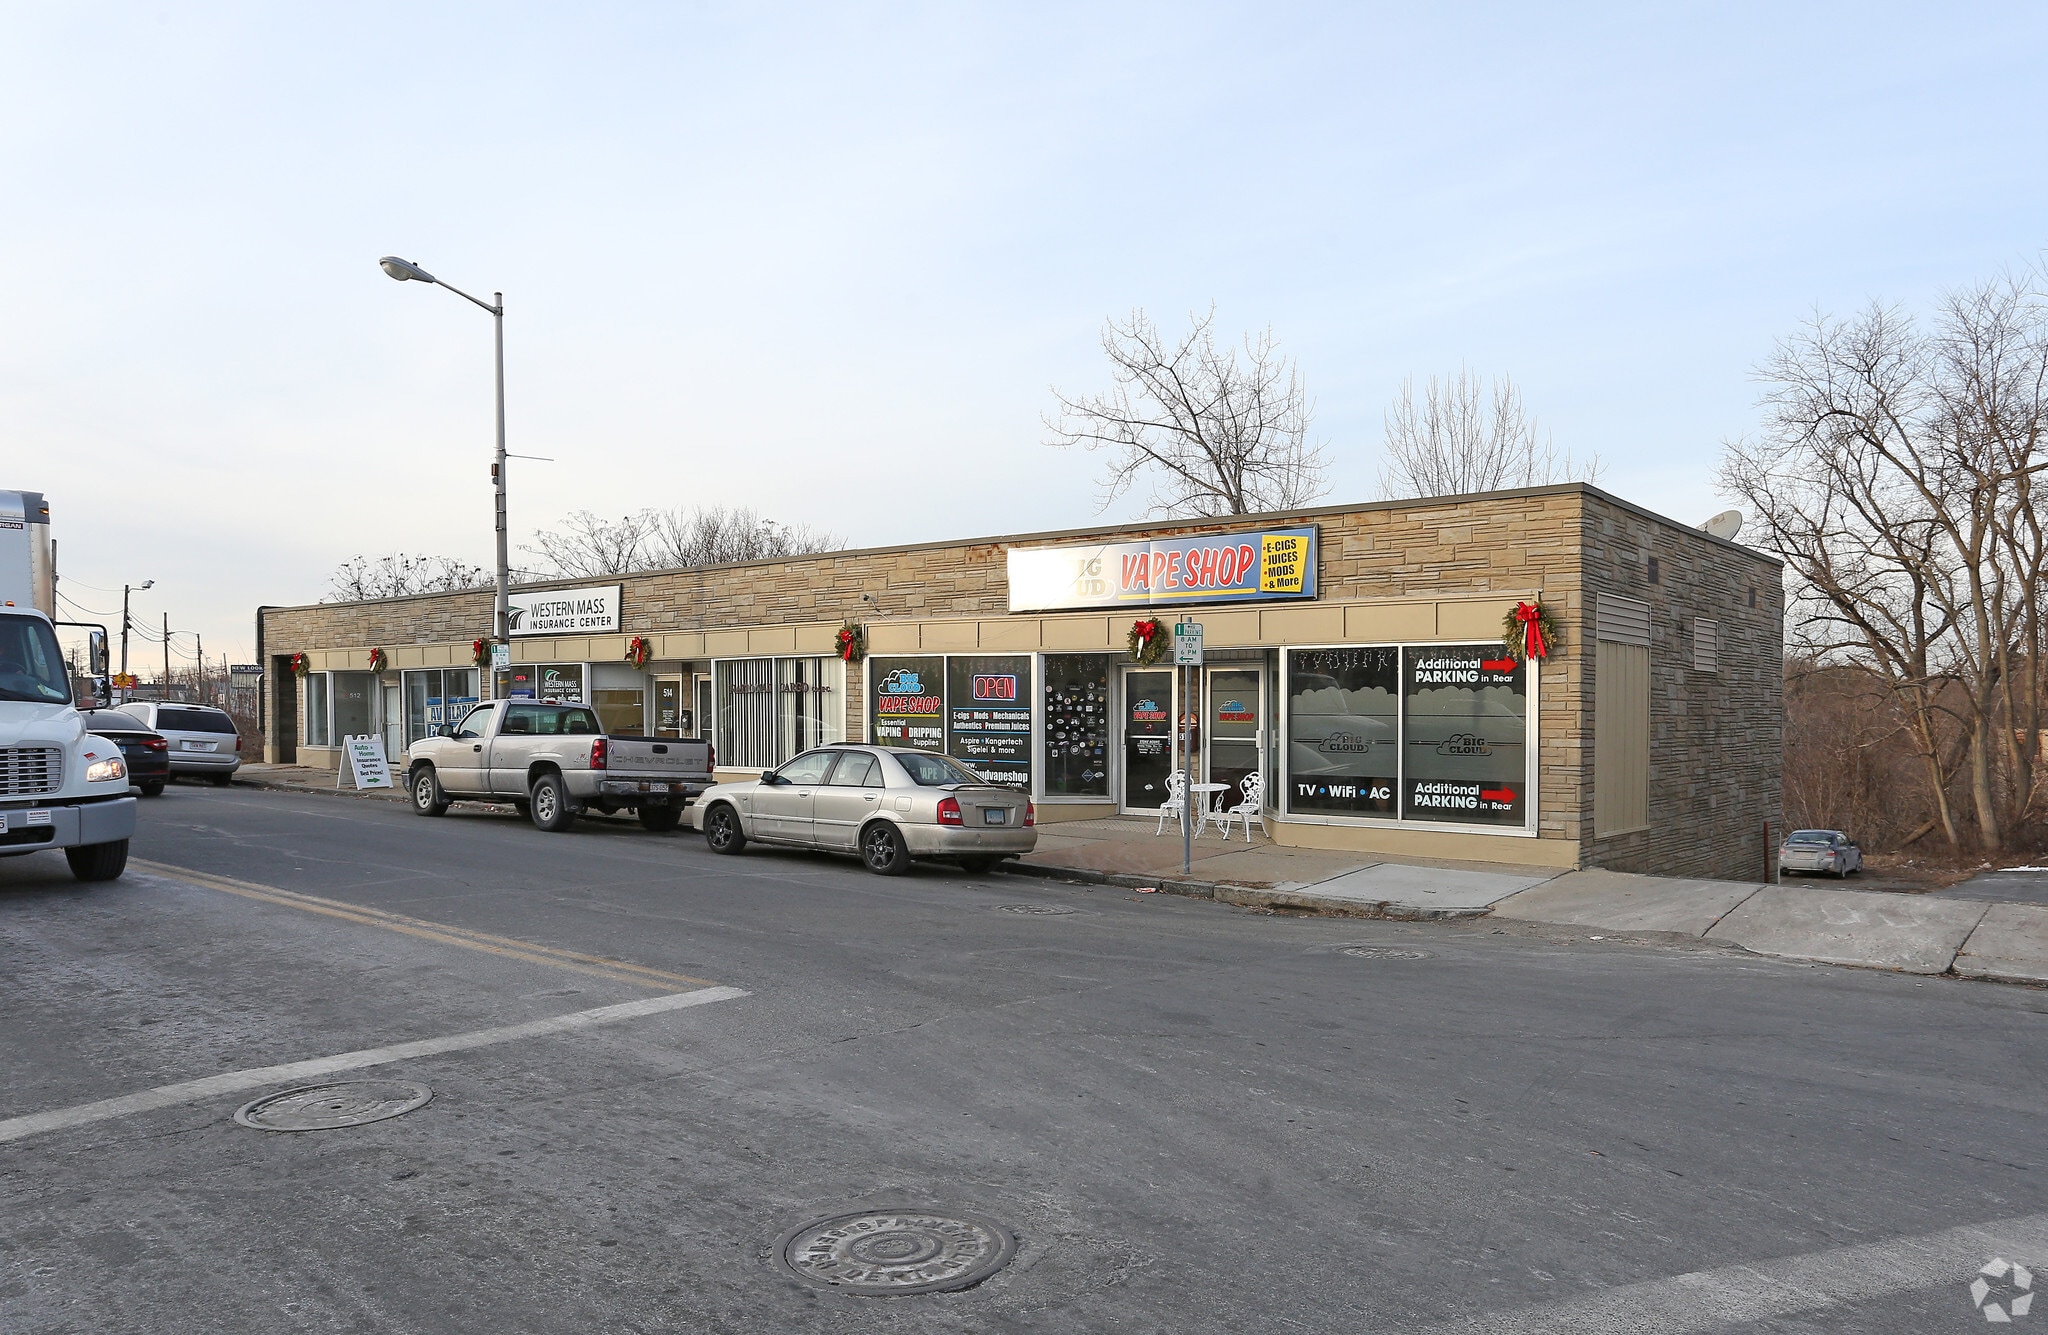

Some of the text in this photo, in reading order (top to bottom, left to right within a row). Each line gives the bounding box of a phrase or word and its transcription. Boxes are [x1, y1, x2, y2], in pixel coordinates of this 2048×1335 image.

[1266, 538, 1297, 553] E-CIGS
[1267, 551, 1298, 566] JUICES
[1121, 551, 1182, 591] VAPE
[1183, 544, 1256, 588] SHOP
[1267, 564, 1295, 578] MODS
[1269, 577, 1299, 589] & More
[530, 598, 605, 618] WESTERN MASS
[529, 615, 612, 630] INSURANCE CENTER
[1416, 658, 1481, 670] Additional
[899, 673, 919, 683] BIG
[1415, 670, 1514, 683] PARKING in Rear
[544, 680, 577, 688] WESTERN MASS
[887, 682, 920, 693] CLOUD
[975, 677, 1015, 699] OPEN
[662, 688, 673, 698] 514
[878, 695, 941, 714] VAPE SHOP
[953, 711, 1030, 720] E-cigs Mods Mechanicals
[1133, 711, 1167, 720] VAPE SHOP
[953, 721, 1030, 730] Authentics Premium Juices
[877, 726, 902, 737] VAPING
[908, 727, 942, 738] DRIPPING
[913, 738, 939, 747] Supplies
[960, 736, 1023, 746] Aspire Kangertech
[1342, 735, 1362, 744] BIG
[1463, 738, 1485, 746] BIG
[1329, 743, 1364, 752] CLOUD
[613, 755, 703, 766] CHEVROLET
[1298, 783, 1391, 800] TV WiFi AC
[1415, 782, 1480, 796] Additional
[1414, 794, 1513, 811] PARKING in Rear
